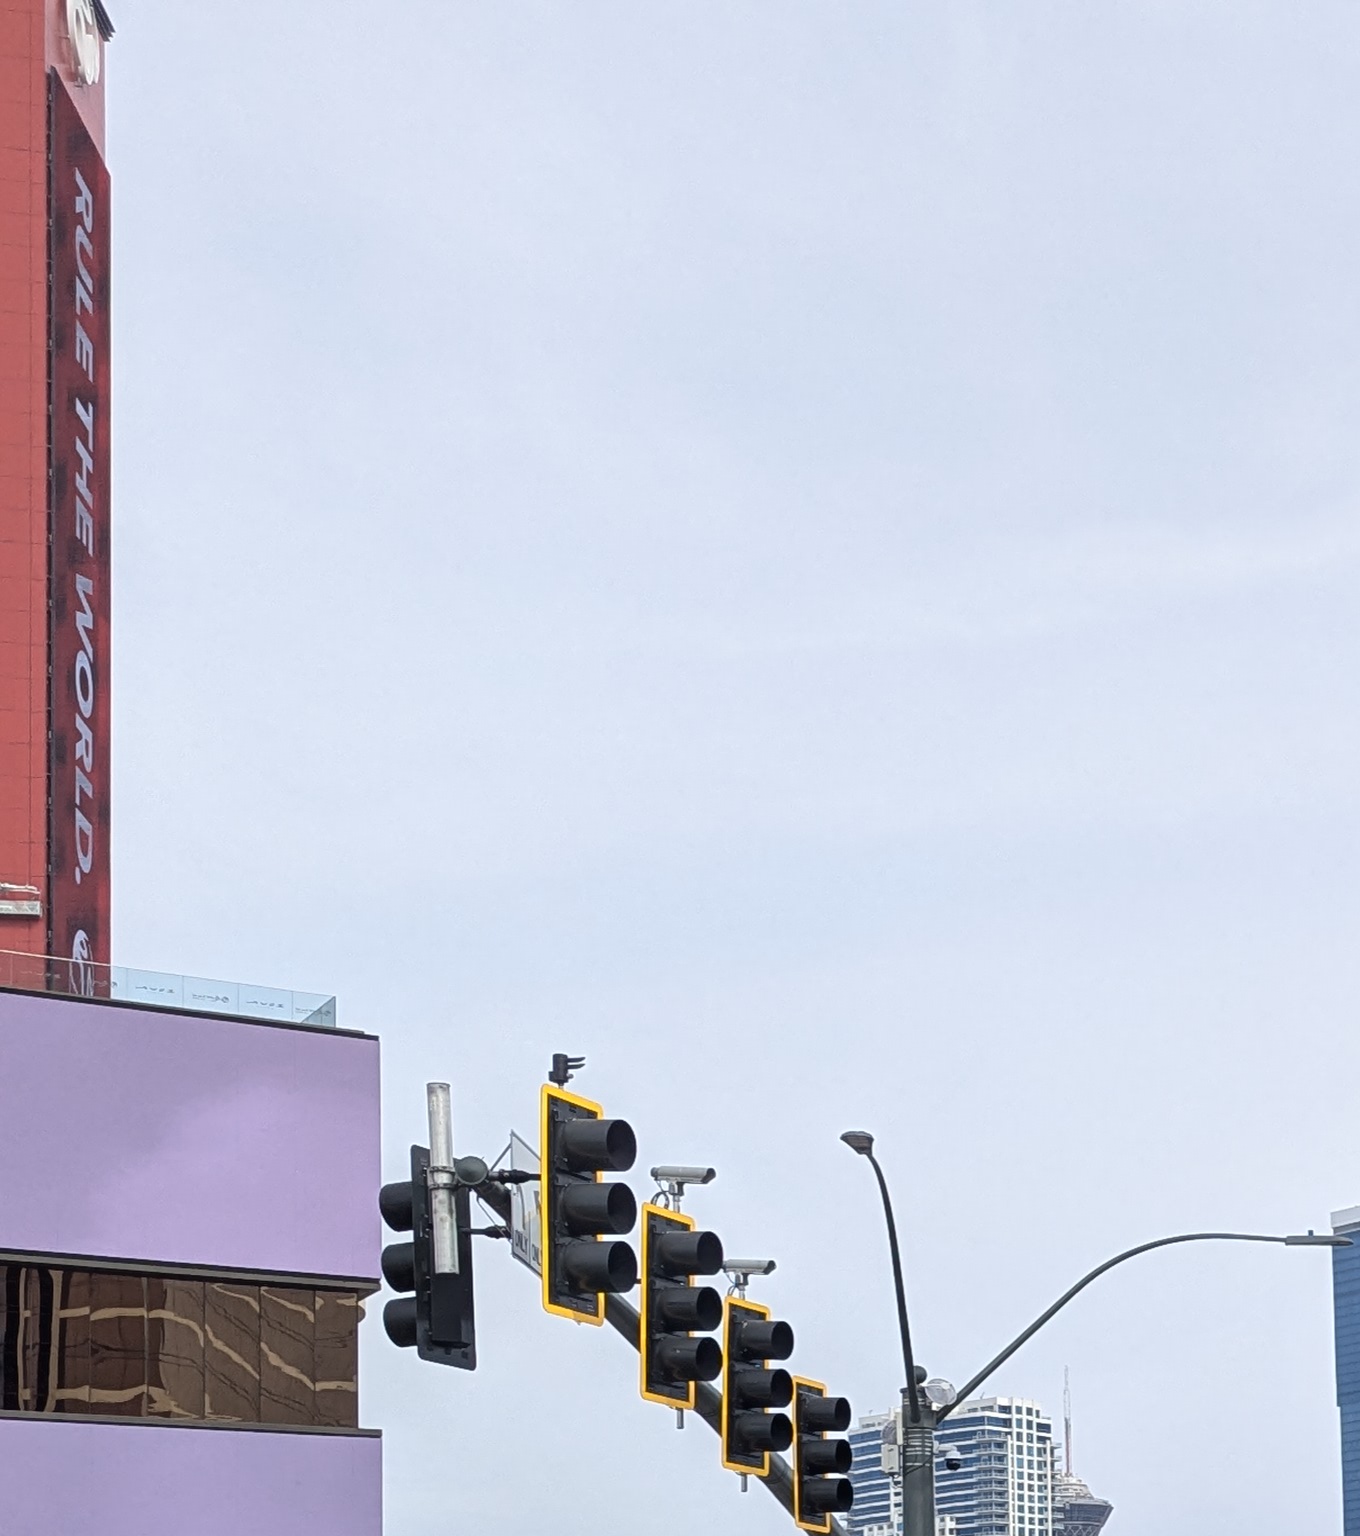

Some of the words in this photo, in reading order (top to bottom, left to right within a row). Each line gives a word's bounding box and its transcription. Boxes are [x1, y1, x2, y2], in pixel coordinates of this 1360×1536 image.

[74, 166, 95, 384] RULE
[74, 396, 95, 560] THE
[73, 576, 95, 884] WORLD.
